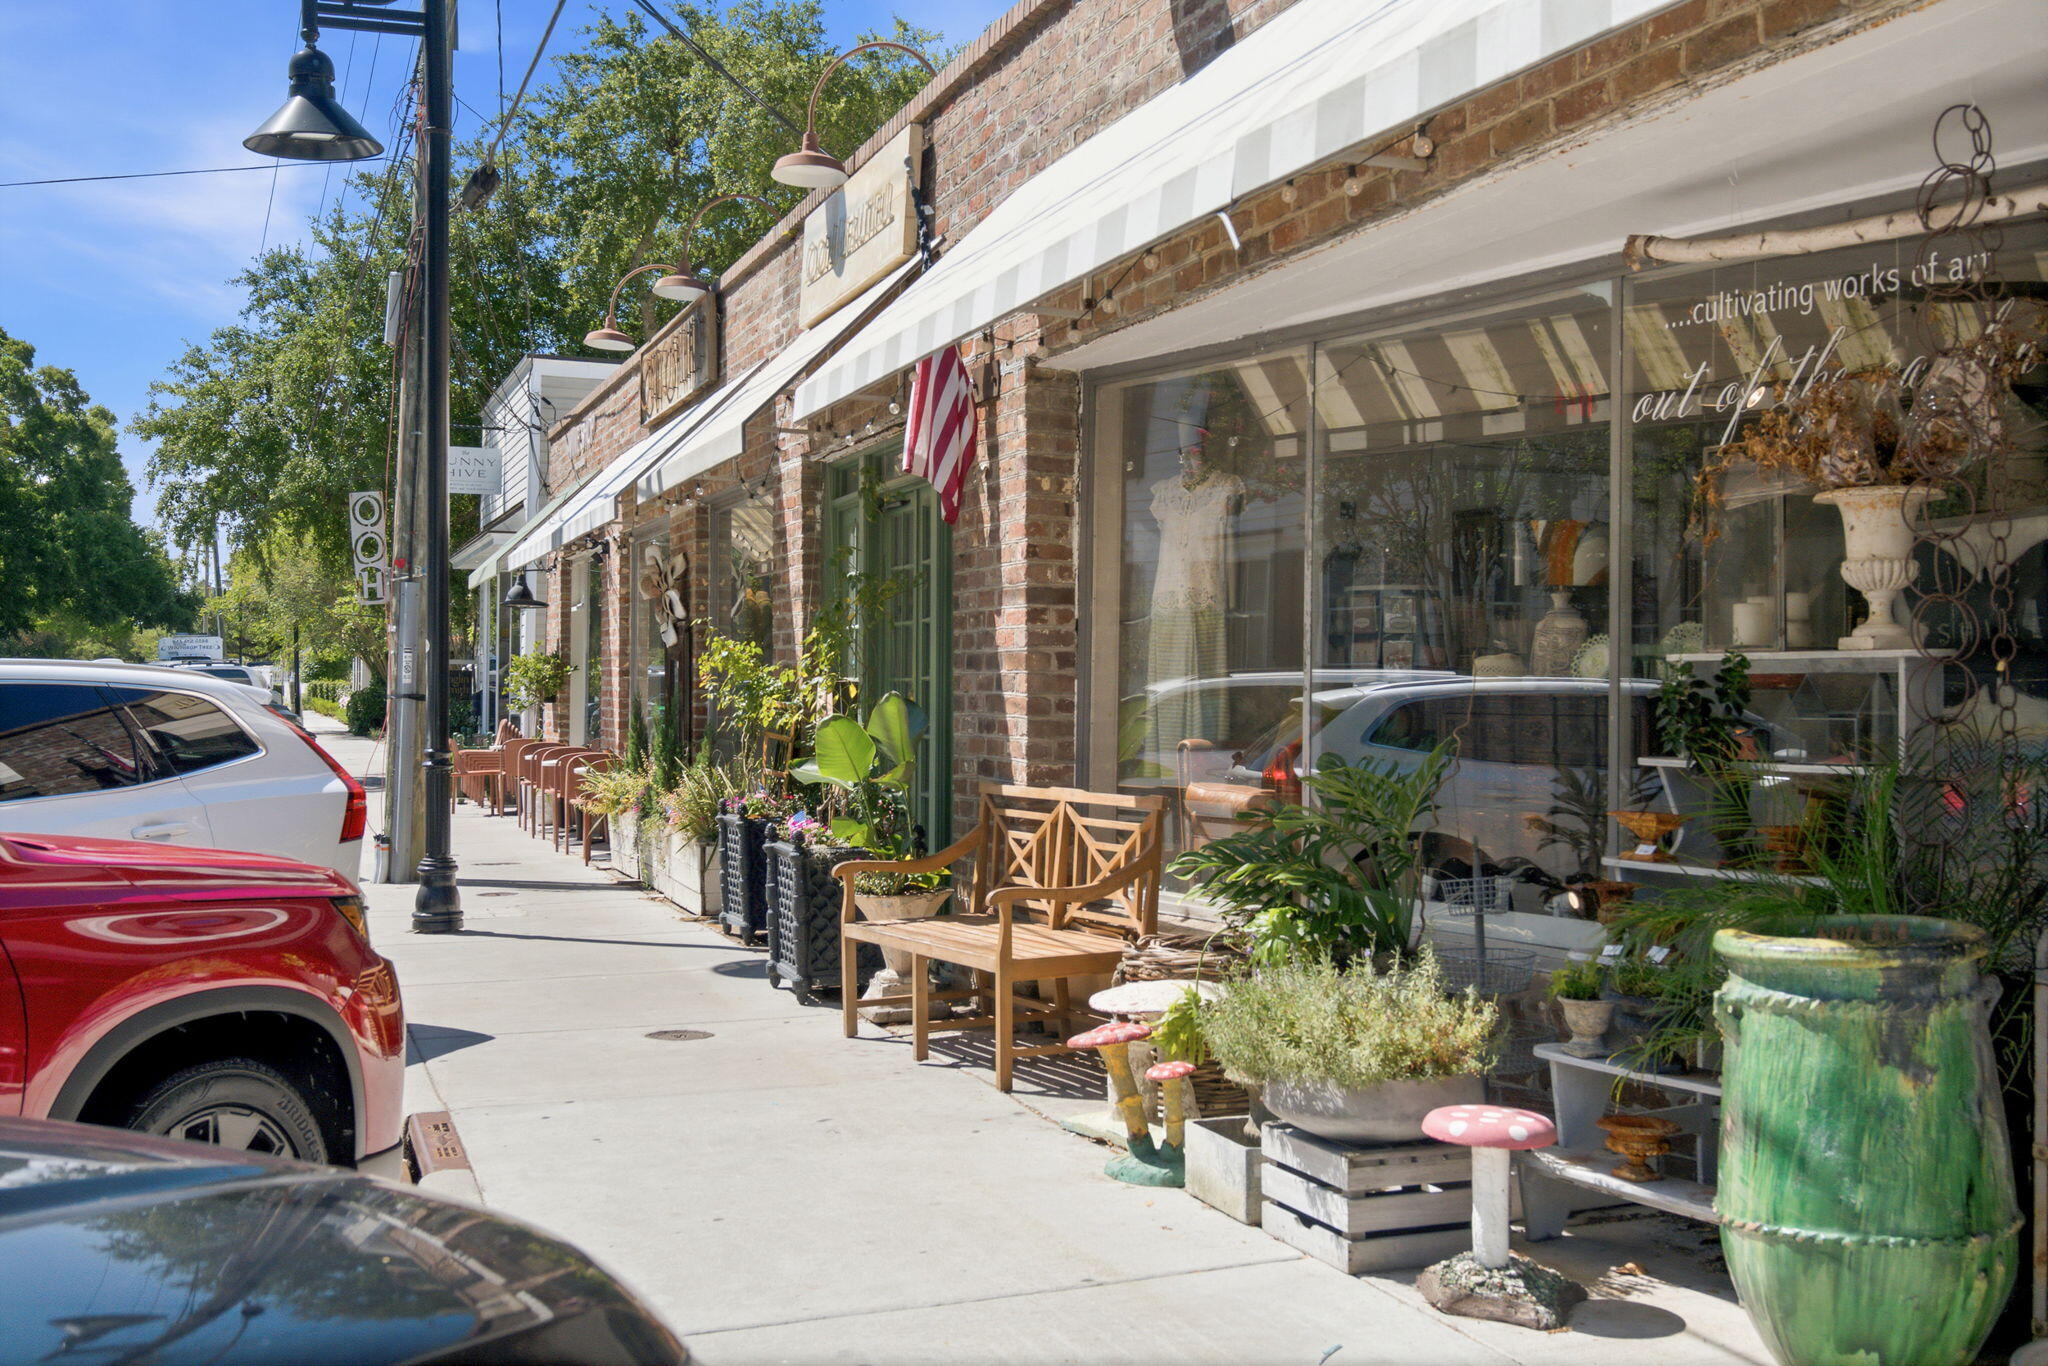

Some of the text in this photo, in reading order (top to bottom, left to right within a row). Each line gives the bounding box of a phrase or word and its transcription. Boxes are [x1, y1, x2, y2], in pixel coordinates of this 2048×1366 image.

[1823, 263, 1900, 301] works
[1911, 252, 1938, 288] of
[1632, 361, 1711, 423] out
[1716, 335, 1783, 446] of
[449, 457, 497, 467] UNNY
[276, 1094, 325, 1165] BRIDGES
